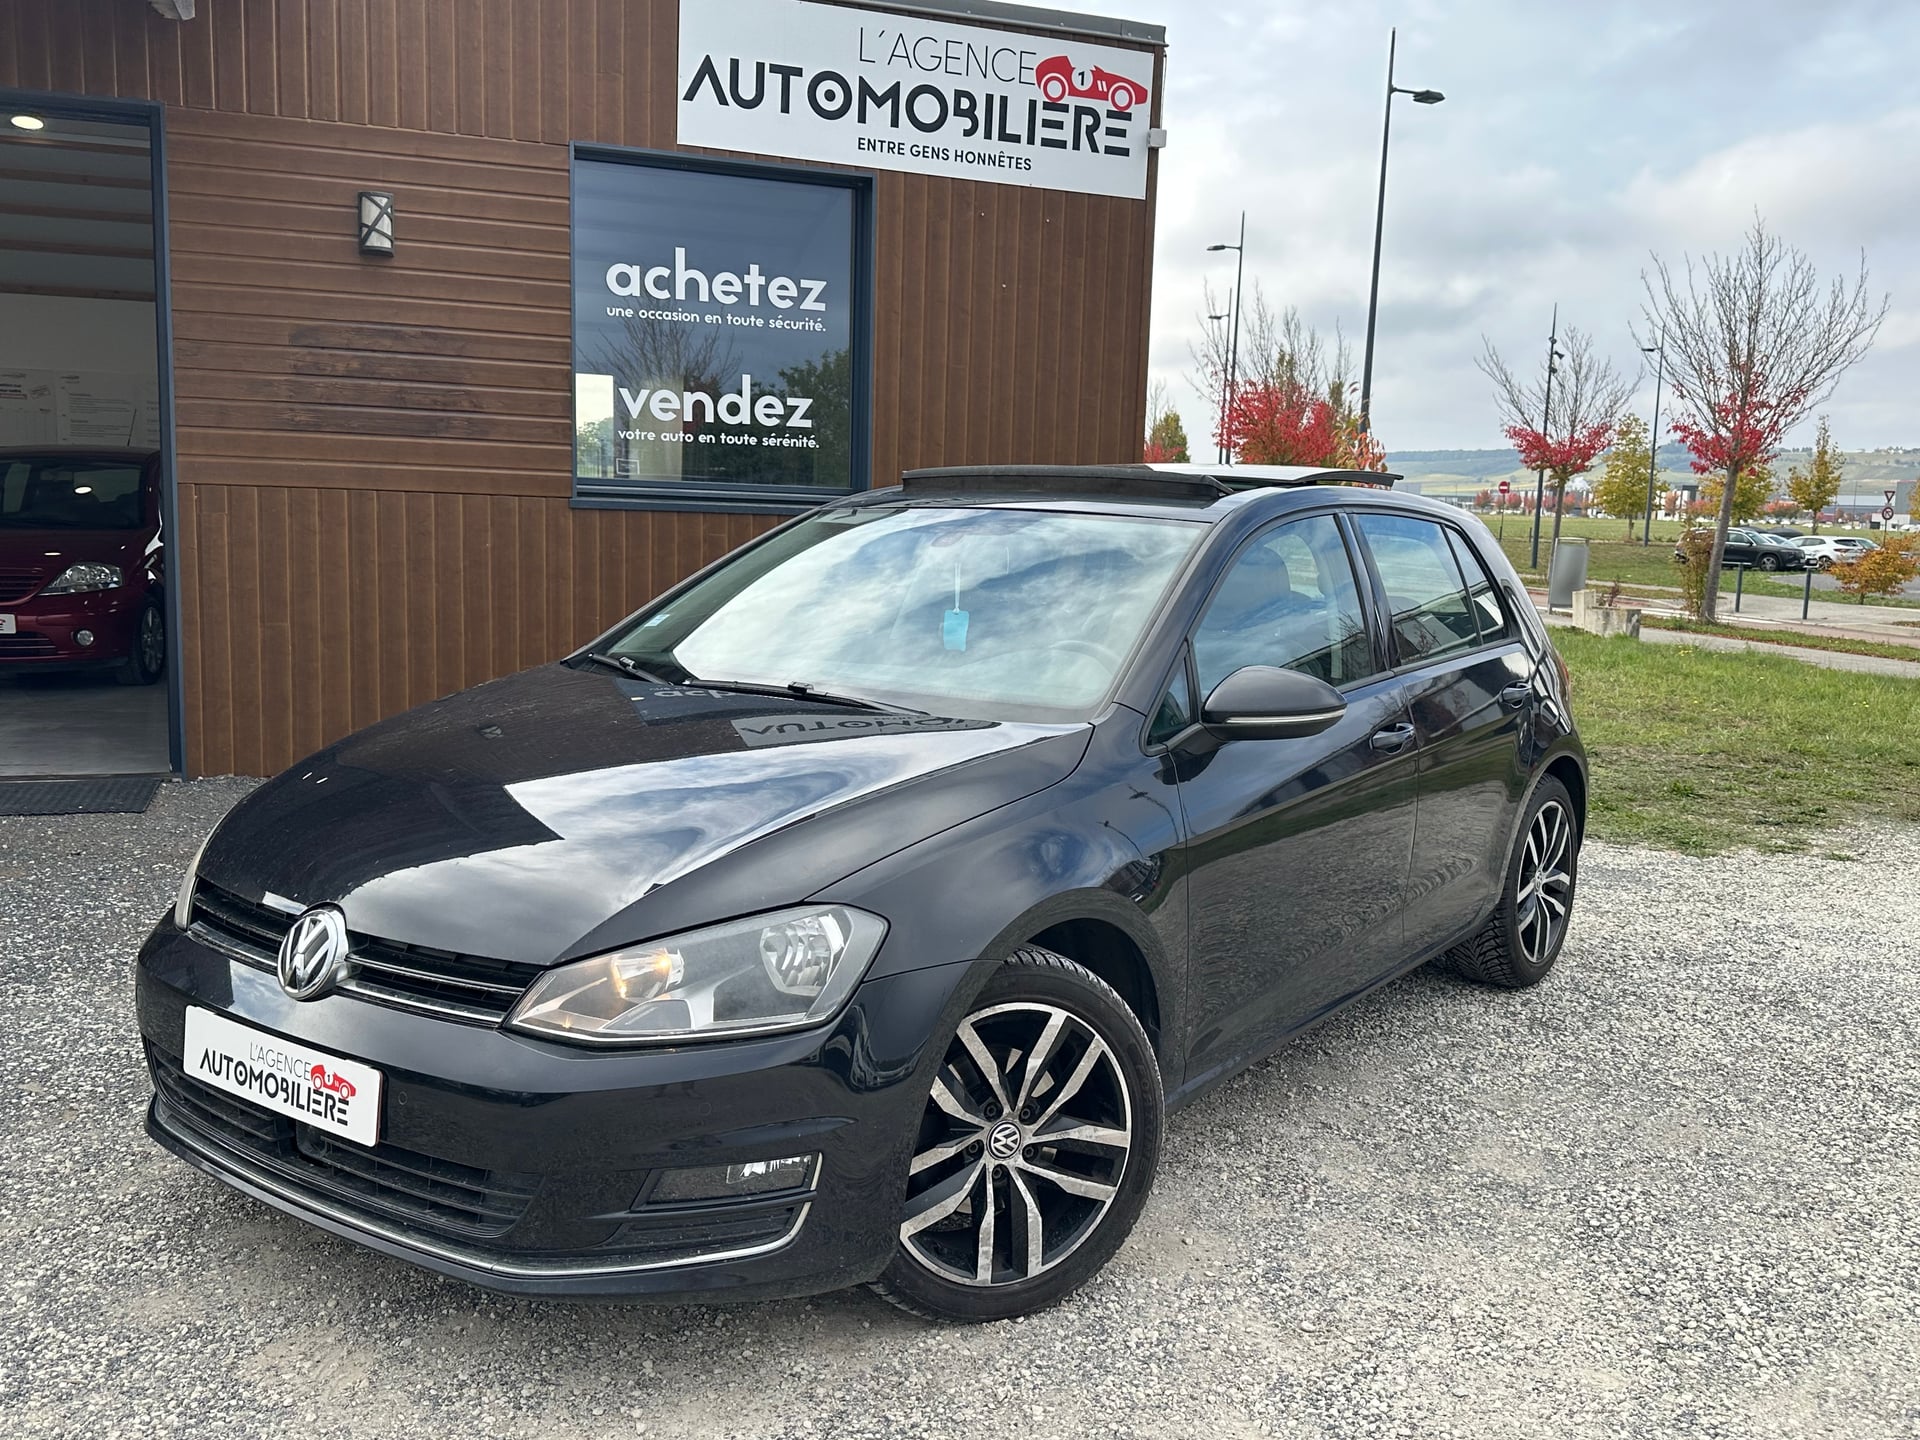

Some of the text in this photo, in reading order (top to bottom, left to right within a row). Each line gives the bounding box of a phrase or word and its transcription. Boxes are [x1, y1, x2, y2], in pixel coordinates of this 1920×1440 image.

[682, 54, 1134, 158] AUTOMOBILIERE
[857, 136, 1032, 171] ENTRE GENS HONNÊTES
[605, 246, 827, 312] achetez
[606, 306, 827, 332] une occasion en toute sécurité.
[618, 373, 814, 428] vendez
[617, 428, 820, 449] votre auto en toute sérénité.
[250, 1041, 312, 1082] L'AGENCE
[199, 1047, 350, 1127] AUTOMOBILIERE
